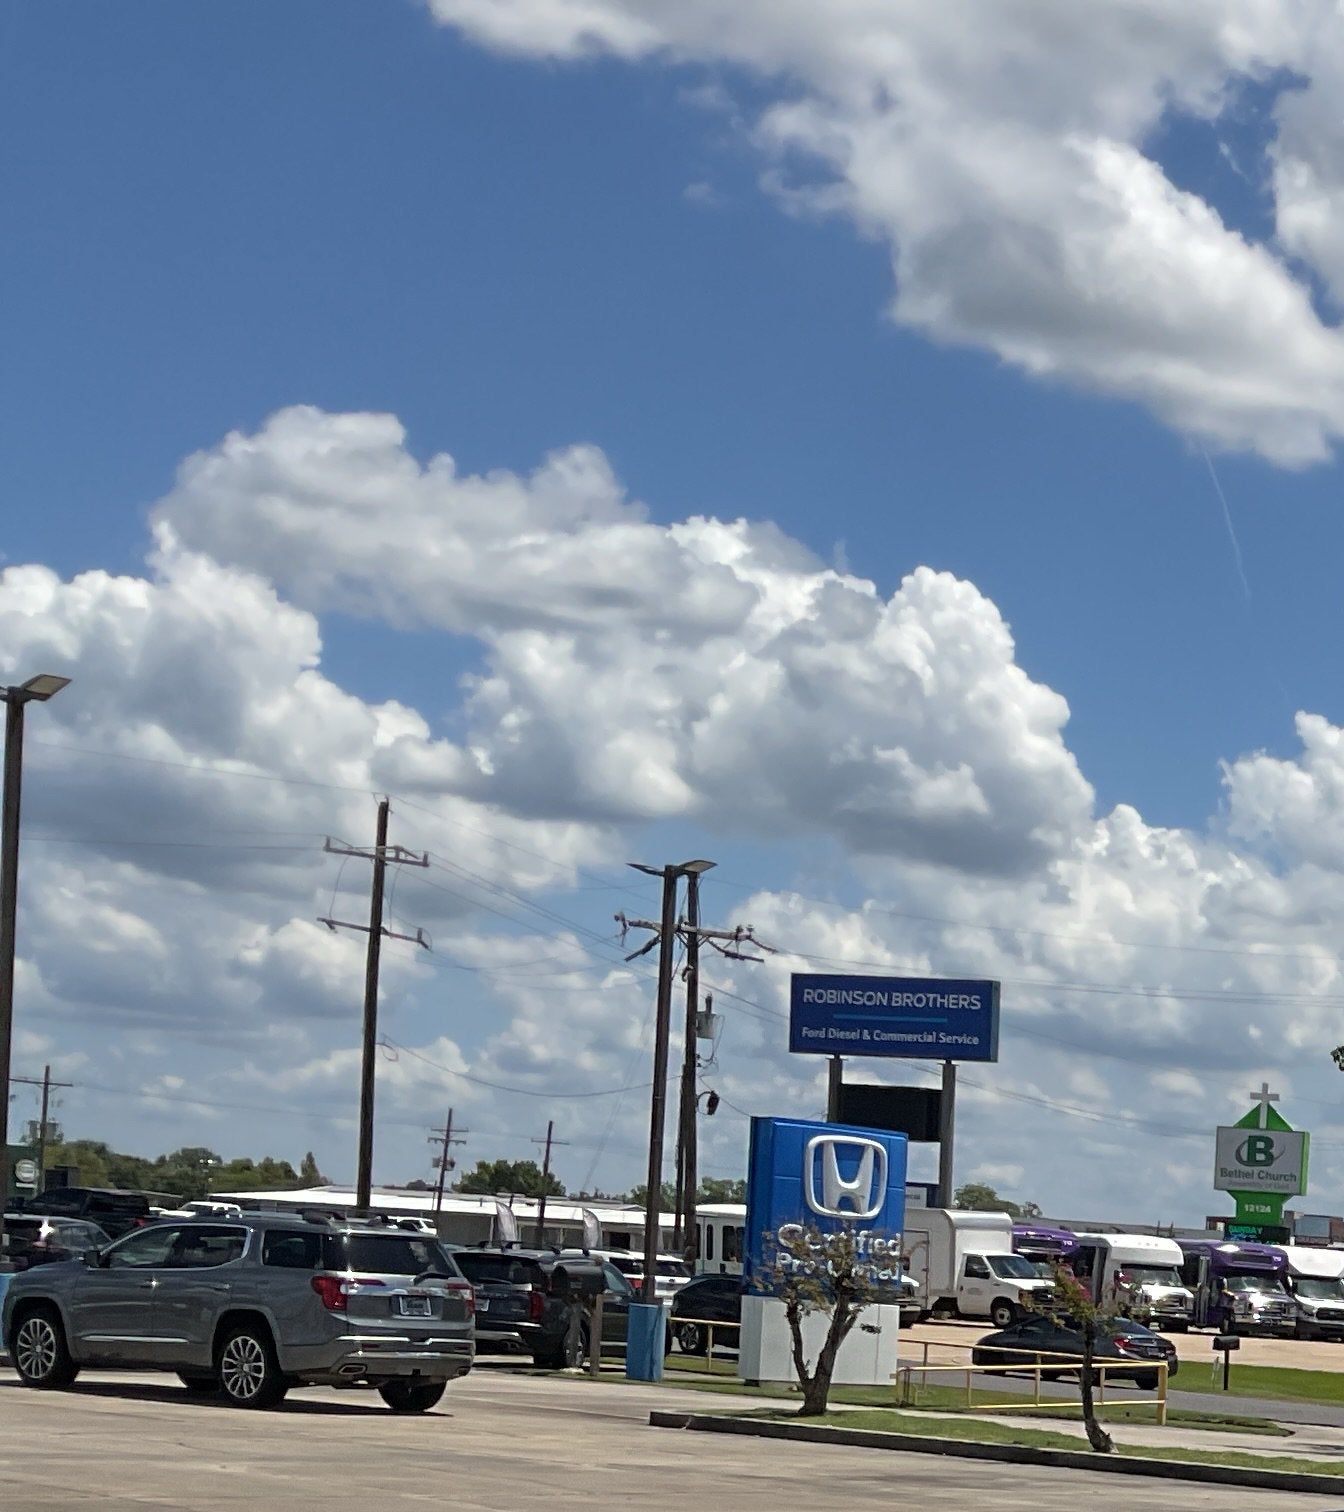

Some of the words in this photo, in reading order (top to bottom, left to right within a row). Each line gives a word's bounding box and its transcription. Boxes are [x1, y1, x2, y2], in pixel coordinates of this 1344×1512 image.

[803, 989, 889, 1006] ROBINSON
[891, 993, 982, 1010] BROTHERS
[802, 1027, 826, 1039] Ford
[829, 1028, 860, 1041] Diesel
[862, 1030, 871, 1040] &
[873, 1029, 937, 1044] Commercial
[939, 1032, 980, 1045] Service
[1220, 1167, 1255, 1179] Bethel
[1257, 1170, 1297, 1182] Church
